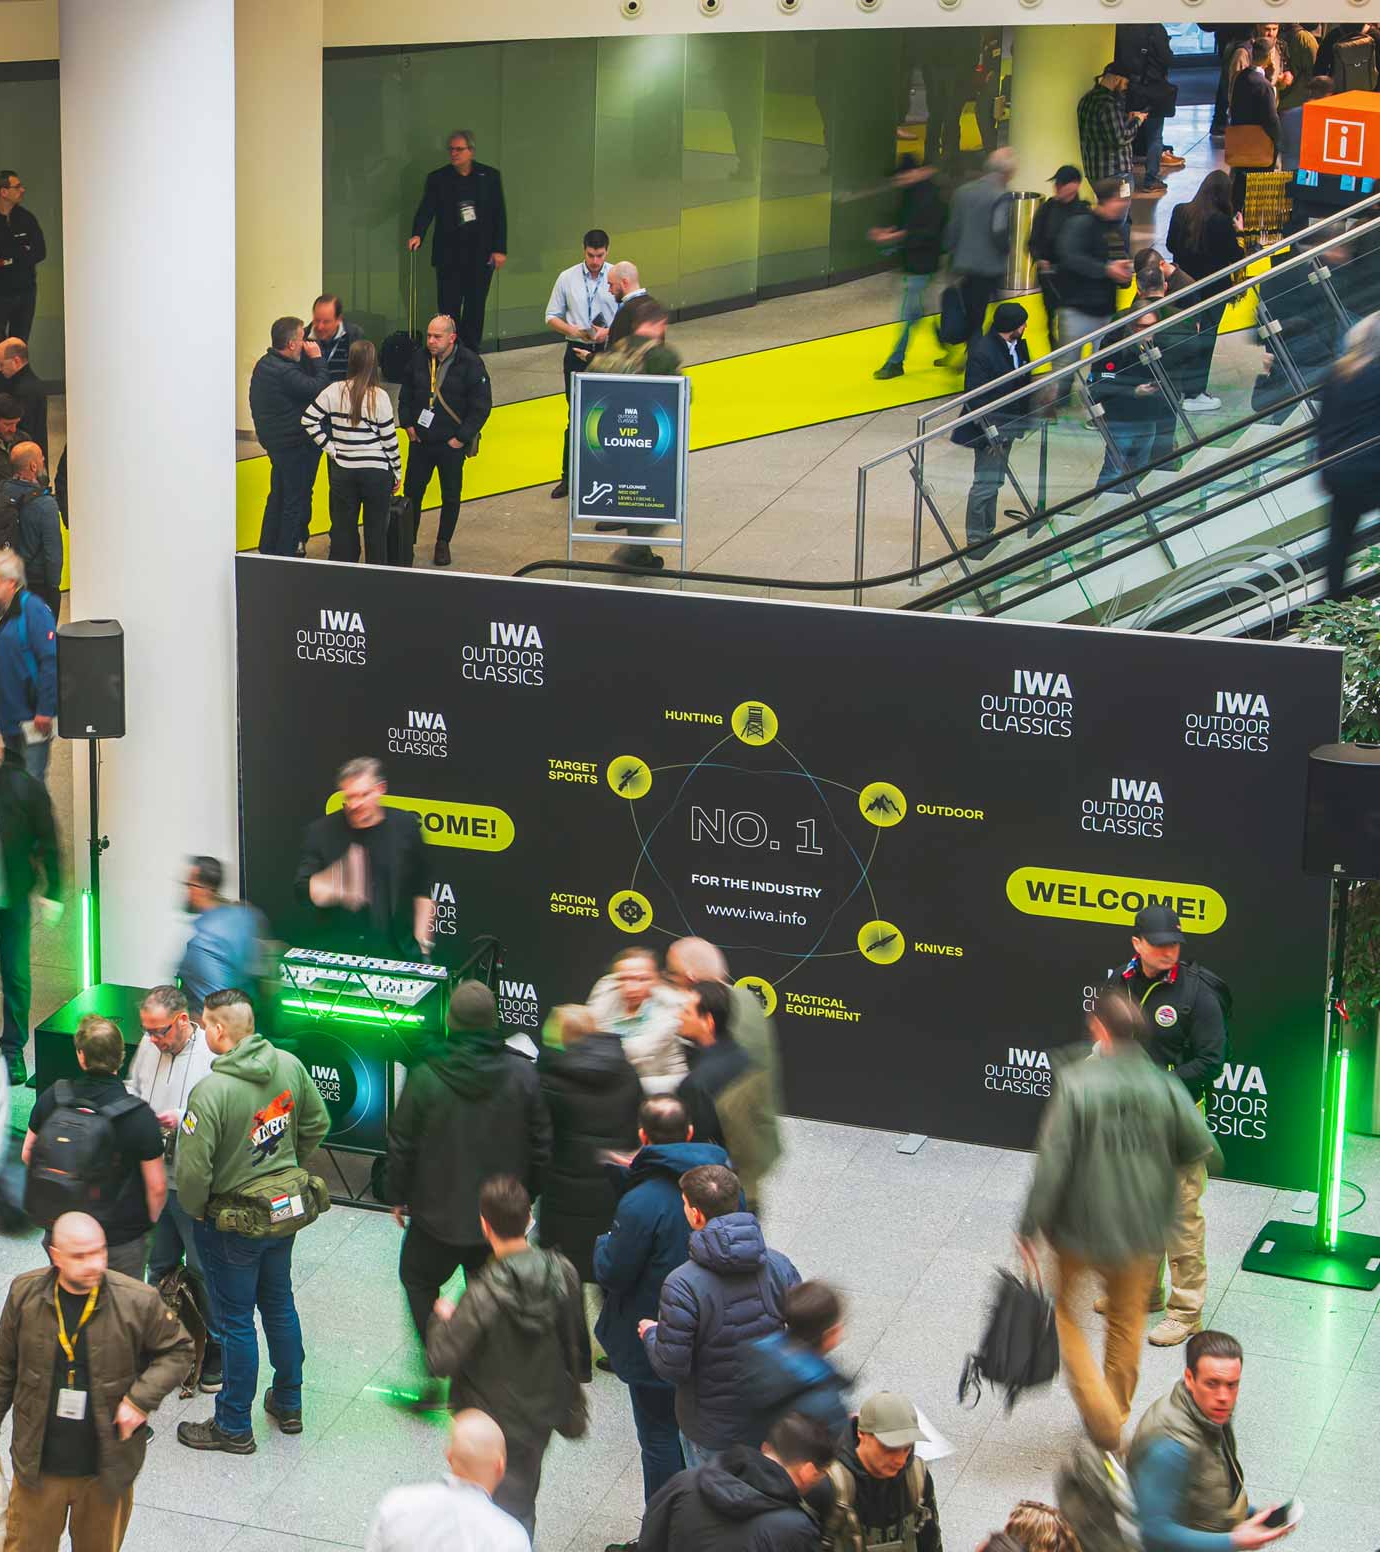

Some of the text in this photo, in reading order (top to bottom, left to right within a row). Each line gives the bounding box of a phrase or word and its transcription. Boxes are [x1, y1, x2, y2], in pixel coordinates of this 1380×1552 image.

[624, 407, 638, 415] IWA
[619, 427, 639, 437] VIP
[604, 437, 653, 449] LOUNGE
[320, 609, 365, 634] IWA
[296, 629, 366, 649] OUTDOOR
[490, 621, 543, 649] IWA
[297, 645, 366, 666] CLASSICS
[462, 645, 544, 668] OUTDOOR
[462, 663, 544, 686] CLASSICS
[1013, 669, 1073, 699] IWA
[981, 694, 1073, 718] OUTDOOR
[1216, 691, 1270, 717] IWA
[408, 710, 447, 731] IWA
[665, 710, 723, 725] HUNTING
[980, 713, 1072, 738] CLASSICS
[1185, 713, 1270, 735] OUTDOOR
[388, 727, 448, 744] OUTDOOR
[1184, 730, 1269, 753] CLASSICS
[388, 740, 448, 758] CLASSICS
[548, 759, 598, 773] TARGET
[548, 770, 599, 785] SPORTS
[1111, 778, 1164, 804] IWA
[916, 804, 984, 820] OUTDOOR
[1081, 799, 1164, 821] OUTDOOR
[423, 811, 498, 840] OME!
[691, 805, 824, 856] NO. 1
[1081, 815, 1163, 838] CLASSICS
[691, 873, 822, 899] FOR THE INDUSTRY
[550, 892, 597, 906] ACTION
[550, 903, 600, 918] SPORTS
[705, 904, 808, 926] www.iwa.info
[914, 942, 964, 957] KNIVES
[499, 980, 538, 1001] IWA
[785, 992, 847, 1010] TACTICAL
[785, 1003, 862, 1023] EQUIPMENT
[1008, 1047, 1051, 1070] IWA
[311, 1064, 340, 1081] IWA
[984, 1063, 1052, 1084] OUTDOOR
[1212, 1062, 1268, 1095] WA
[314, 1079, 341, 1091] DOOR
[320, 1089, 341, 1102] SICS
[984, 1077, 1051, 1098] CLASSICS
[1206, 1113, 1267, 1140] SSICS
